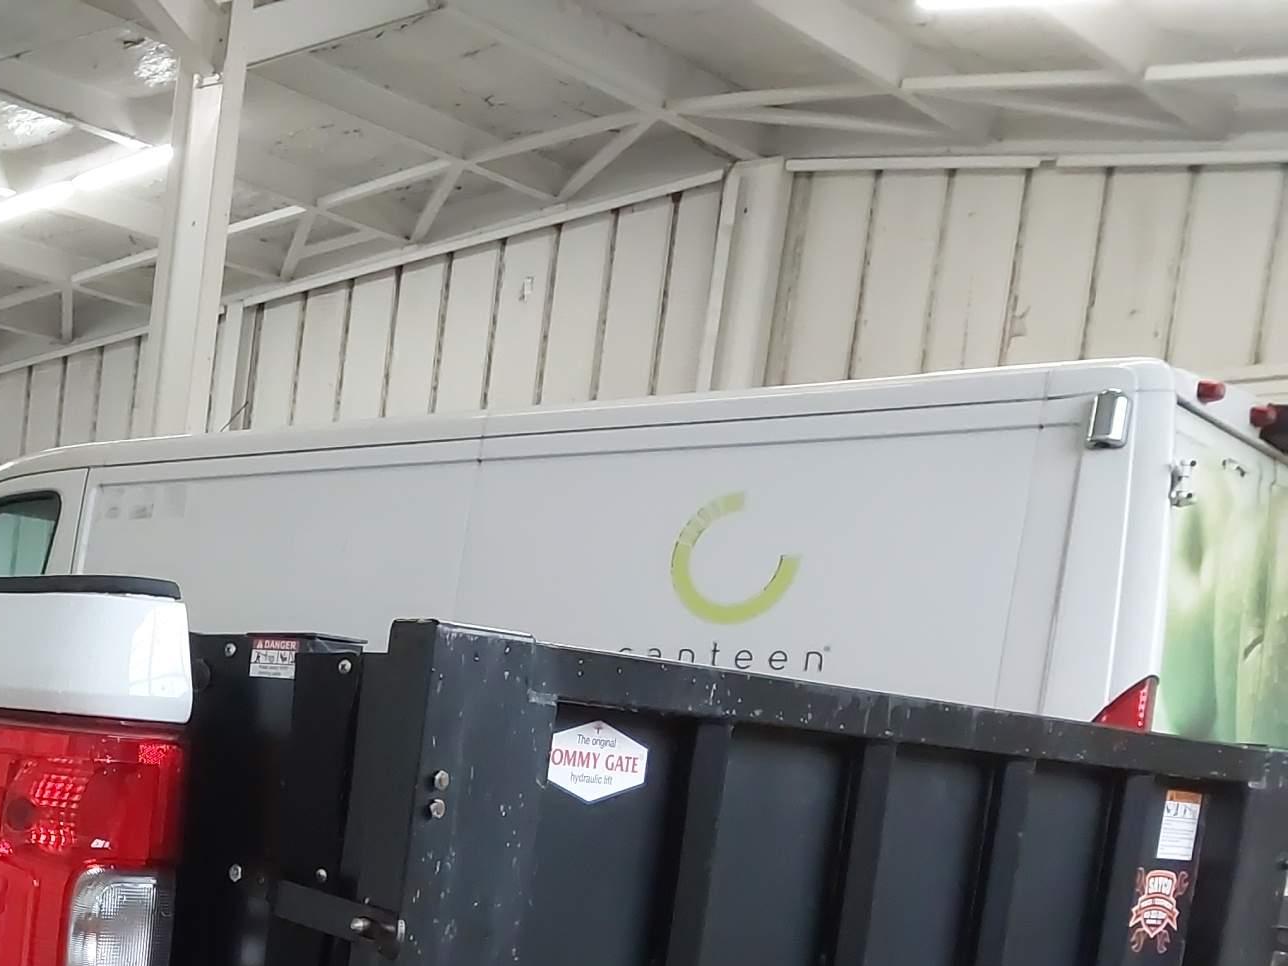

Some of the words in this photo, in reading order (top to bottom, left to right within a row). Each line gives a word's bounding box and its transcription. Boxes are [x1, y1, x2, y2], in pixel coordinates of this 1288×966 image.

[264, 640, 297, 650] DANGER
[618, 642, 824, 672] anteen
[577, 733, 591, 745] The
[592, 736, 617, 750] original
[551, 748, 600, 769] OMMY
[605, 754, 640, 774] GATE
[570, 772, 602, 785] hydraulic
